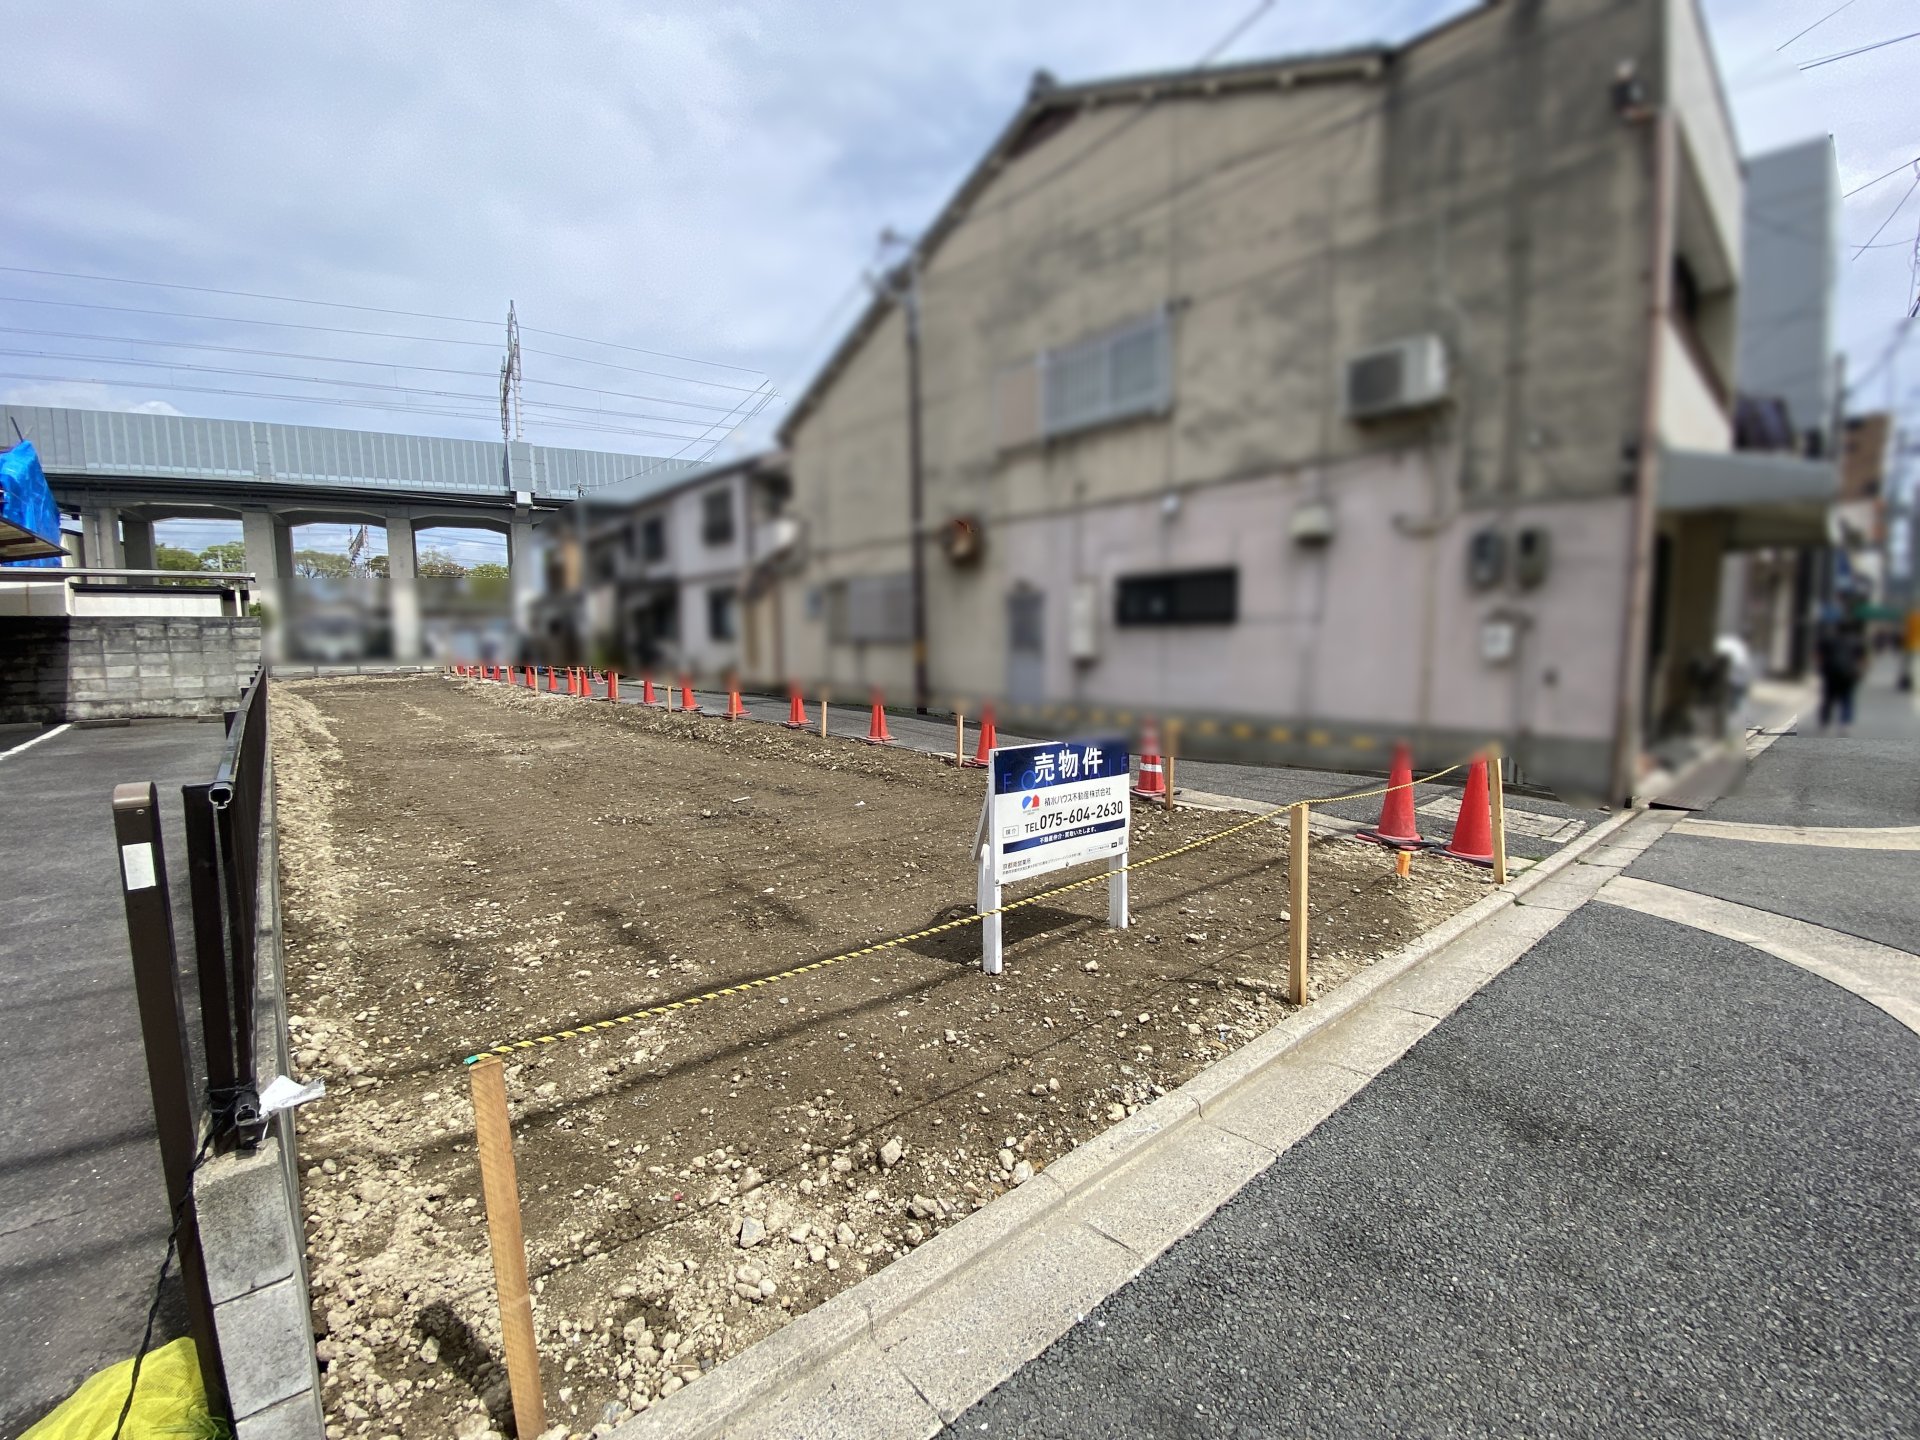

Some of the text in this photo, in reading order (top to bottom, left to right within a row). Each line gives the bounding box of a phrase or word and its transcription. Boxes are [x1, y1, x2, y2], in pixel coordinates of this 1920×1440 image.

[1034, 747, 1103, 783] 売物件
[1044, 787, 1111, 807] 積水ハウス不動産株式会社
